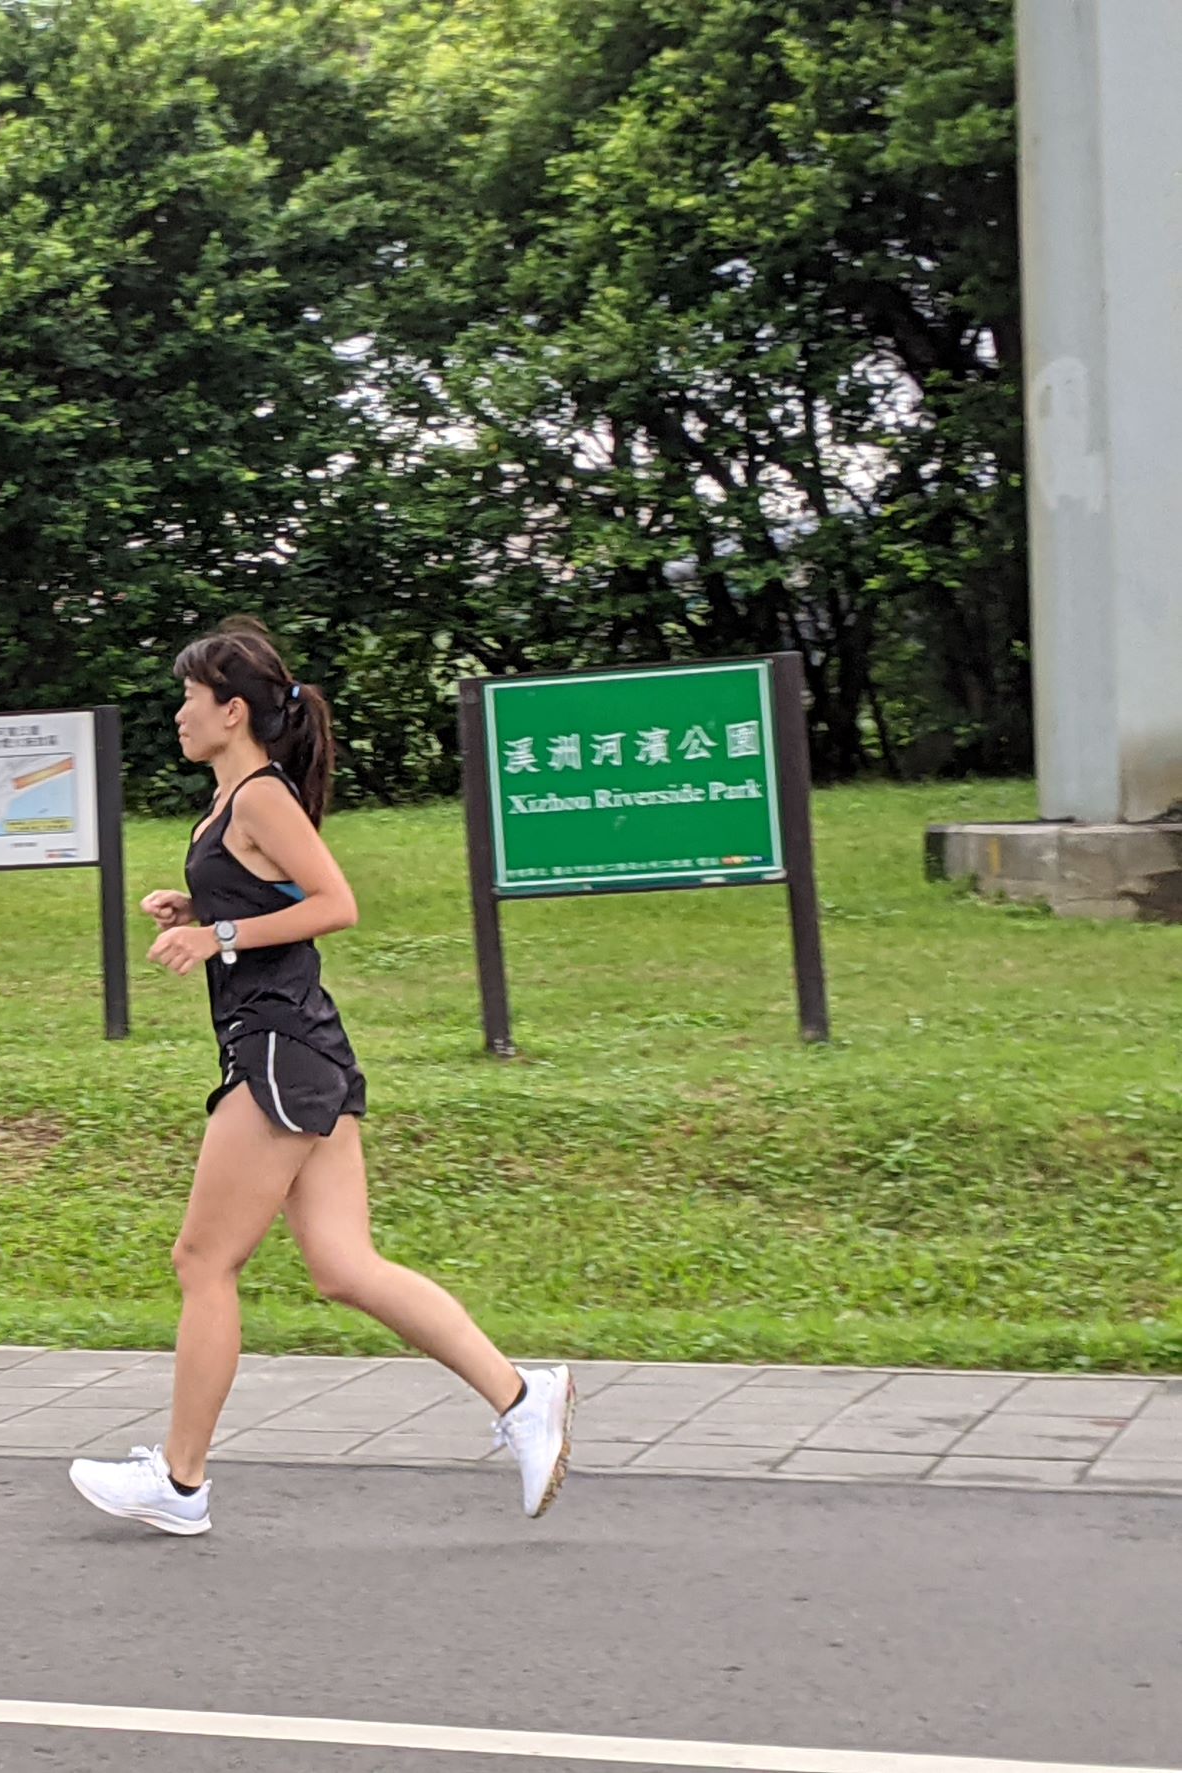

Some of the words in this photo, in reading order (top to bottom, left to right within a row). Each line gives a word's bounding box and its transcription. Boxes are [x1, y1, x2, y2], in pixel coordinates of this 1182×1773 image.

[503, 720, 761, 773] 溪洲河濱公園
[594, 783, 706, 808] Riverside
[708, 779, 763, 800] Park
